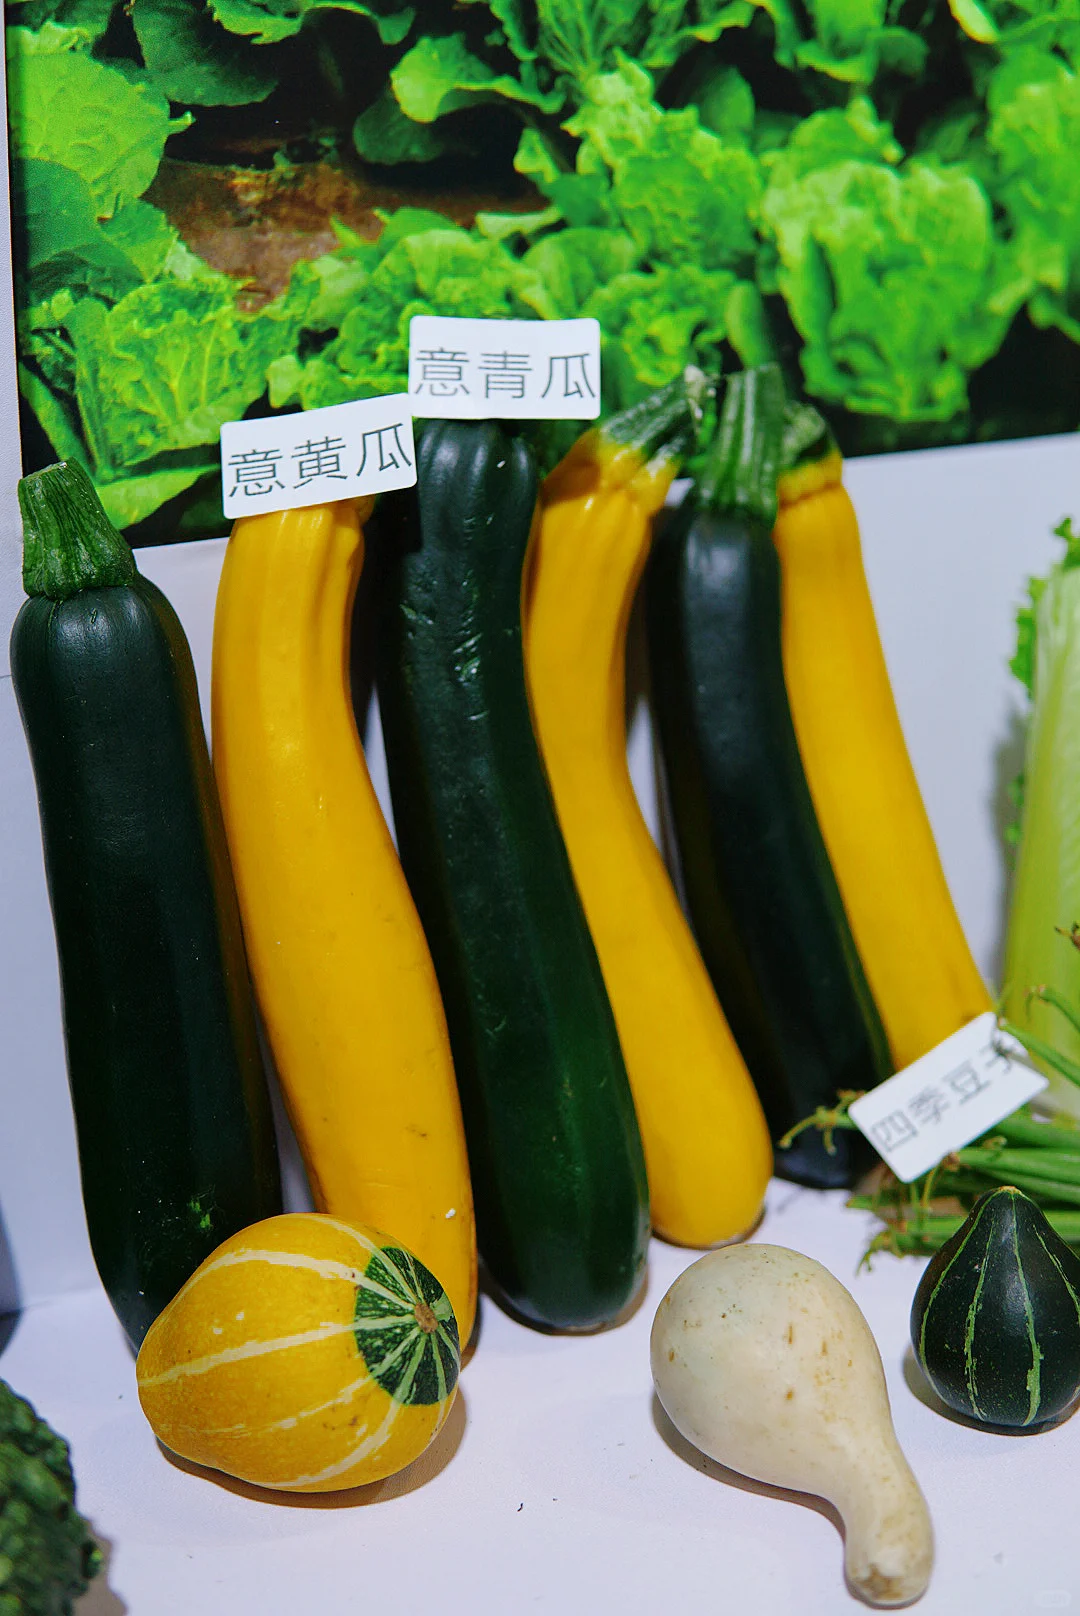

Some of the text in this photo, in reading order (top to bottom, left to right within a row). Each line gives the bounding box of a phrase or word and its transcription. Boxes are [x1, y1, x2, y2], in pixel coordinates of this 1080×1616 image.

[414, 346, 597, 400] 意青瓜
[227, 422, 413, 499] 意黄瓜
